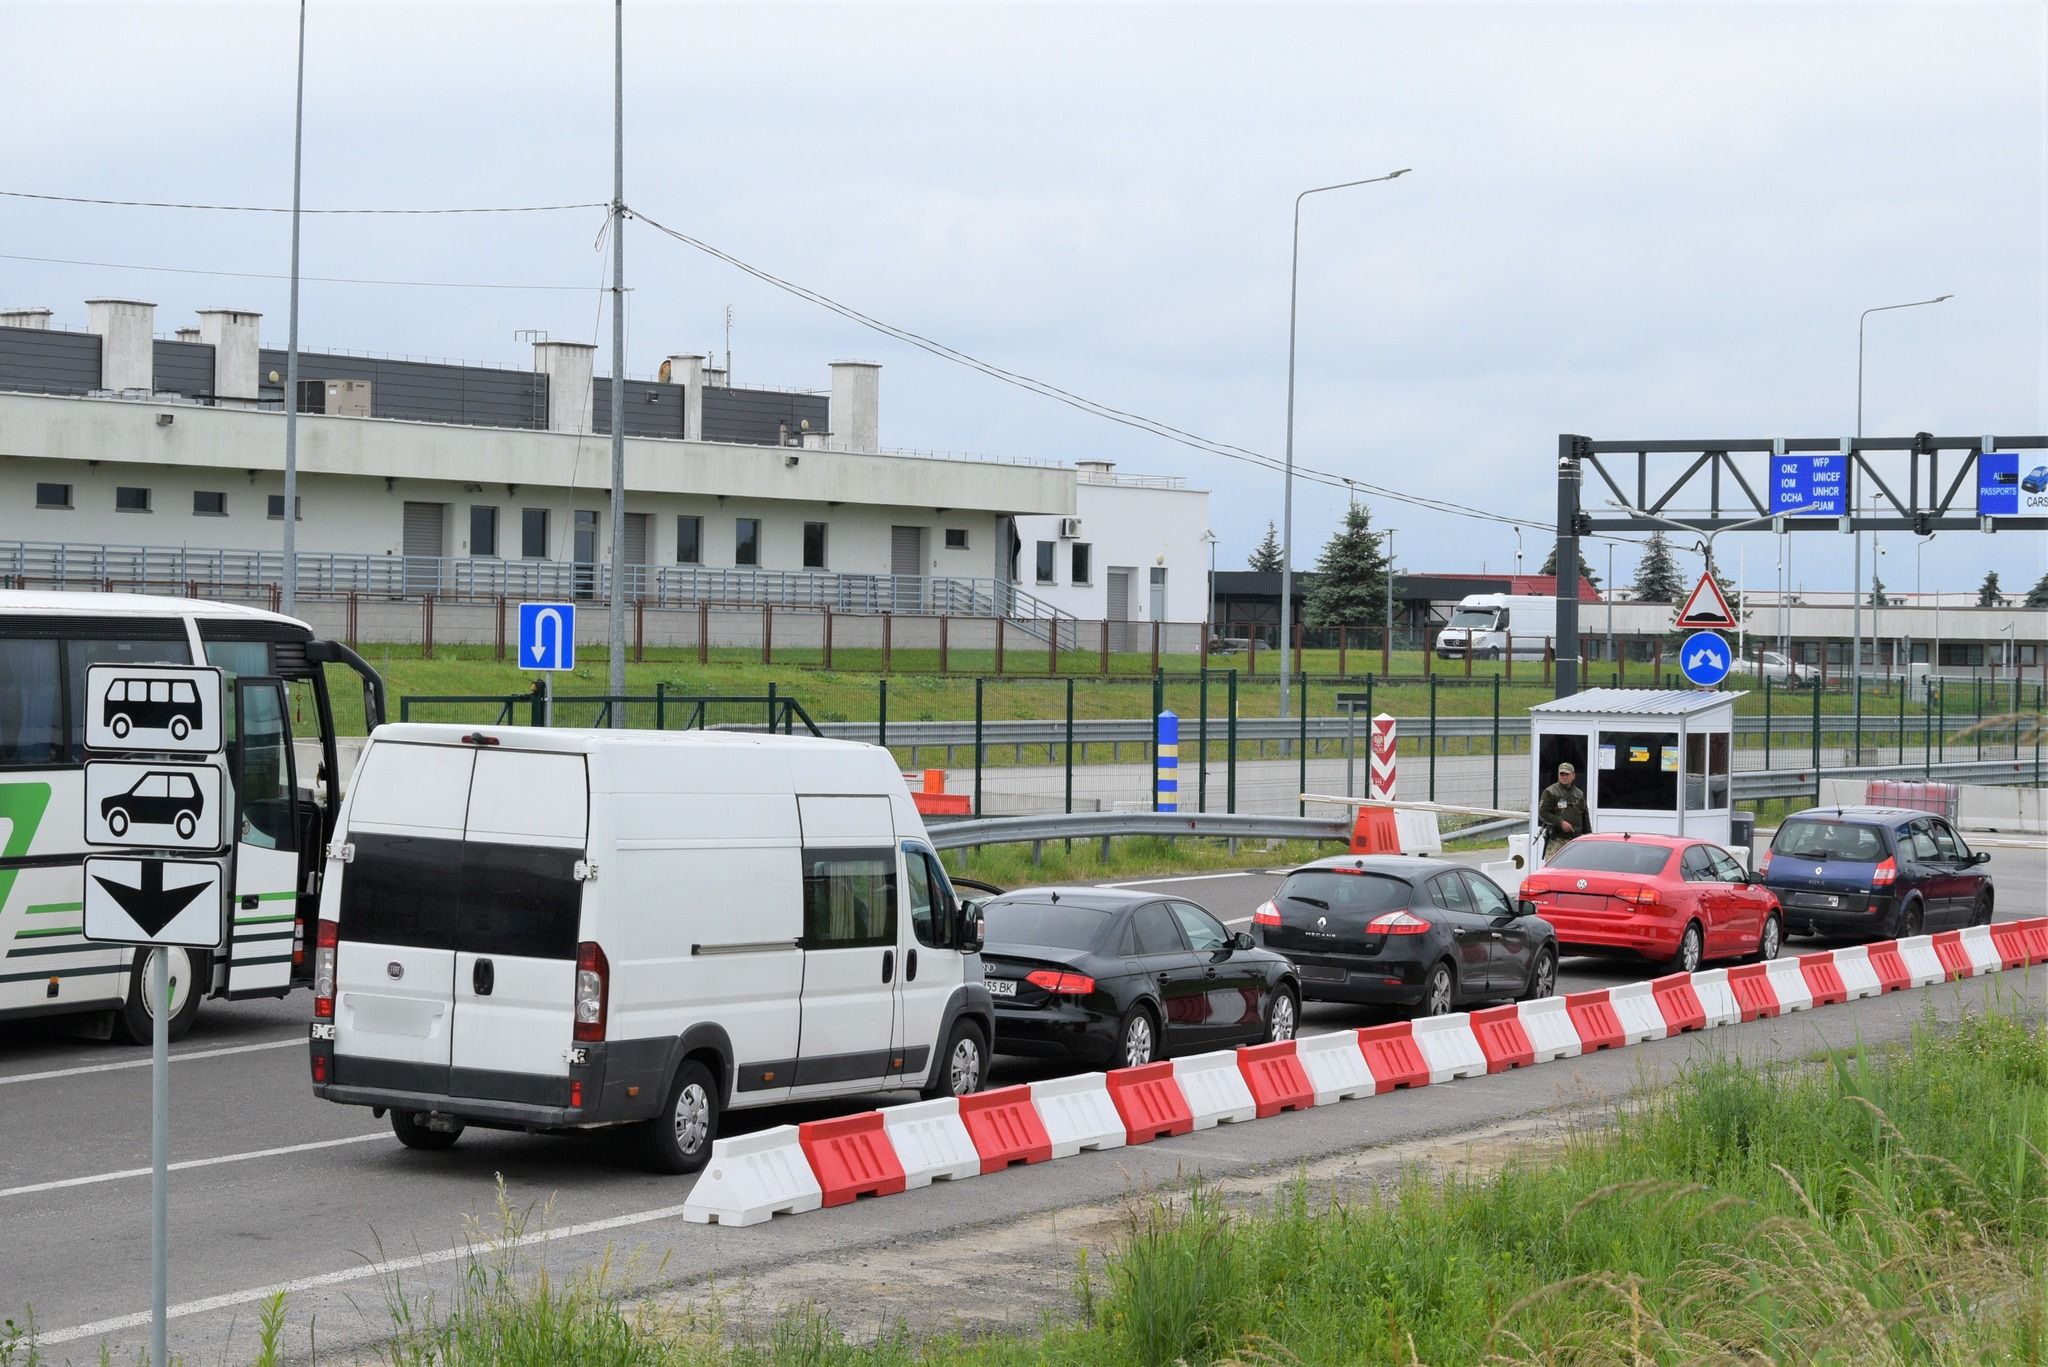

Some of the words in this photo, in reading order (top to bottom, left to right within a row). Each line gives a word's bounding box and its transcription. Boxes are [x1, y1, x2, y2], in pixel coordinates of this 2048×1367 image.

[1813, 458, 1829, 467] WFP
[1781, 464, 1798, 473] ONZ
[1813, 472, 1840, 481] UNICEF
[1781, 479, 1796, 488] IOM
[1813, 487, 1839, 496] UNHCR
[1781, 493, 1803, 502] OCHA
[2027, 497, 2048, 507] CARS
[983, 980, 997, 992] 55
[1000, 982, 1013, 994] BK
